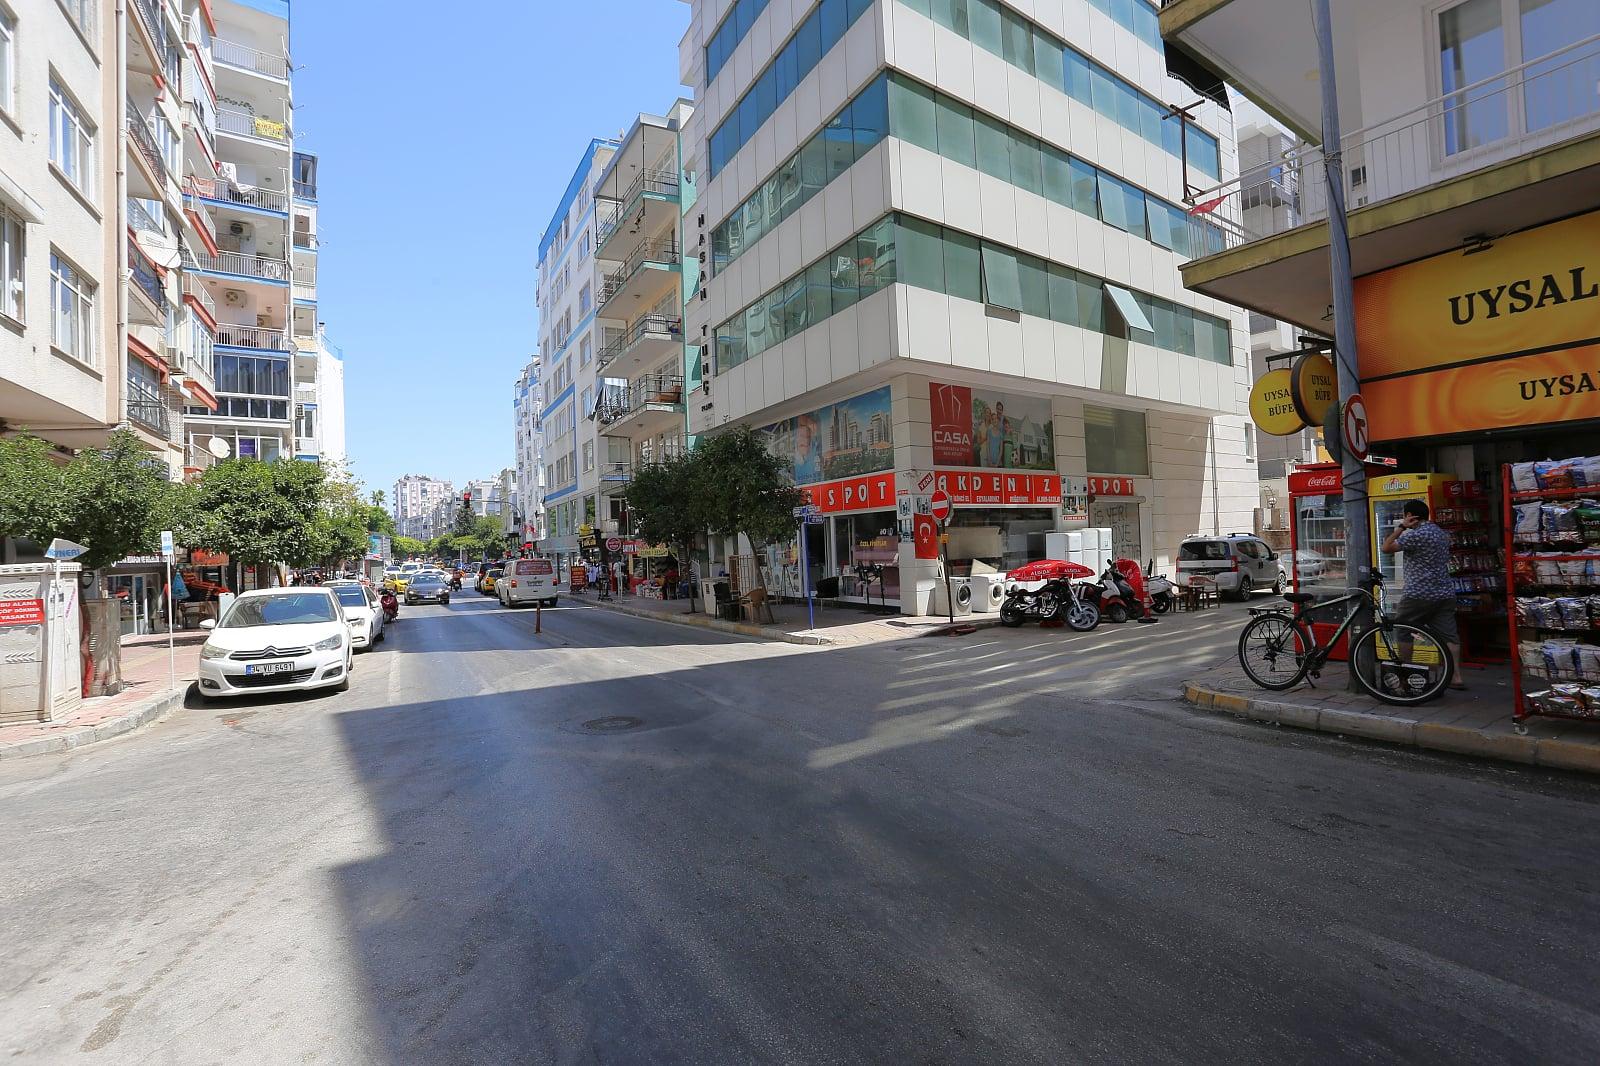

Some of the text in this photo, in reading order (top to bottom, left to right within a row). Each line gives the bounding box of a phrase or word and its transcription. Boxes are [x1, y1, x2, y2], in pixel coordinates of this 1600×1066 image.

[1448, 266, 1598, 325] UYSAL
[1311, 375, 1332, 386] UYSAL
[1519, 371, 1600, 400] UYSA
[1264, 388, 1292, 402] UYSA
[1314, 388, 1331, 401] BÜFE
[1268, 403, 1295, 417] BÜFE
[933, 430, 971, 446] CASA
[938, 474, 1050, 492] AKDENİZ
[1090, 478, 1133, 494] SPOT
[828, 481, 887, 506] SPOT
